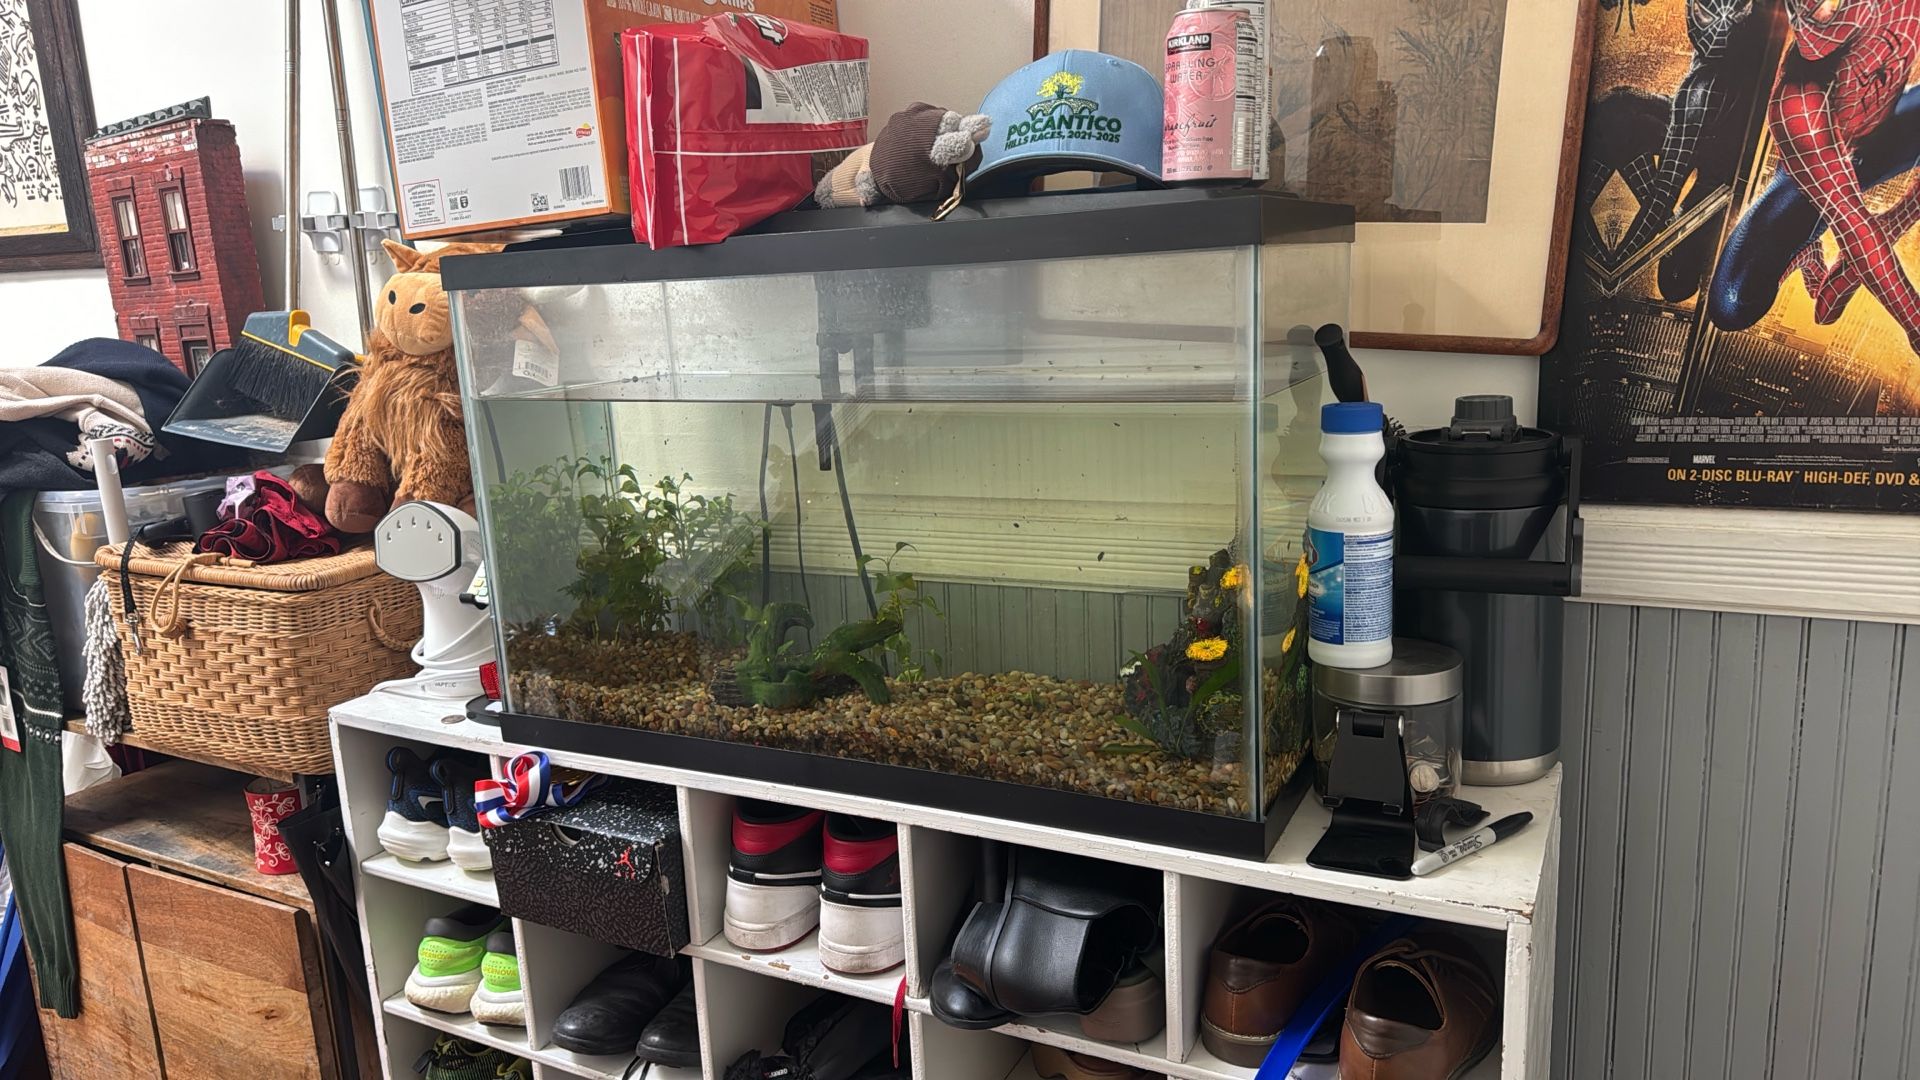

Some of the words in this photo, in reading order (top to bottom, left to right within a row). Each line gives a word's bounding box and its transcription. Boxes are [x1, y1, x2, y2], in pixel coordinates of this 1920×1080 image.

[1168, 34, 1210, 49] KIRKLAND
[1165, 57, 1216, 73] SPARLING
[1006, 114, 1122, 141] POCANTICO
[1004, 136, 1029, 151] HILLS
[1029, 130, 1065, 144] RACES,
[1066, 130, 1121, 144] 2021-2025
[1693, 455, 1716, 464] MARVEL
[1667, 468, 1687, 481] ON
[1689, 469, 1732, 482] 2-DISC
[1804, 471, 1871, 486] HIGH-DEF,
[1875, 472, 1905, 486] DVD
[1908, 473, 1920, 486] &
